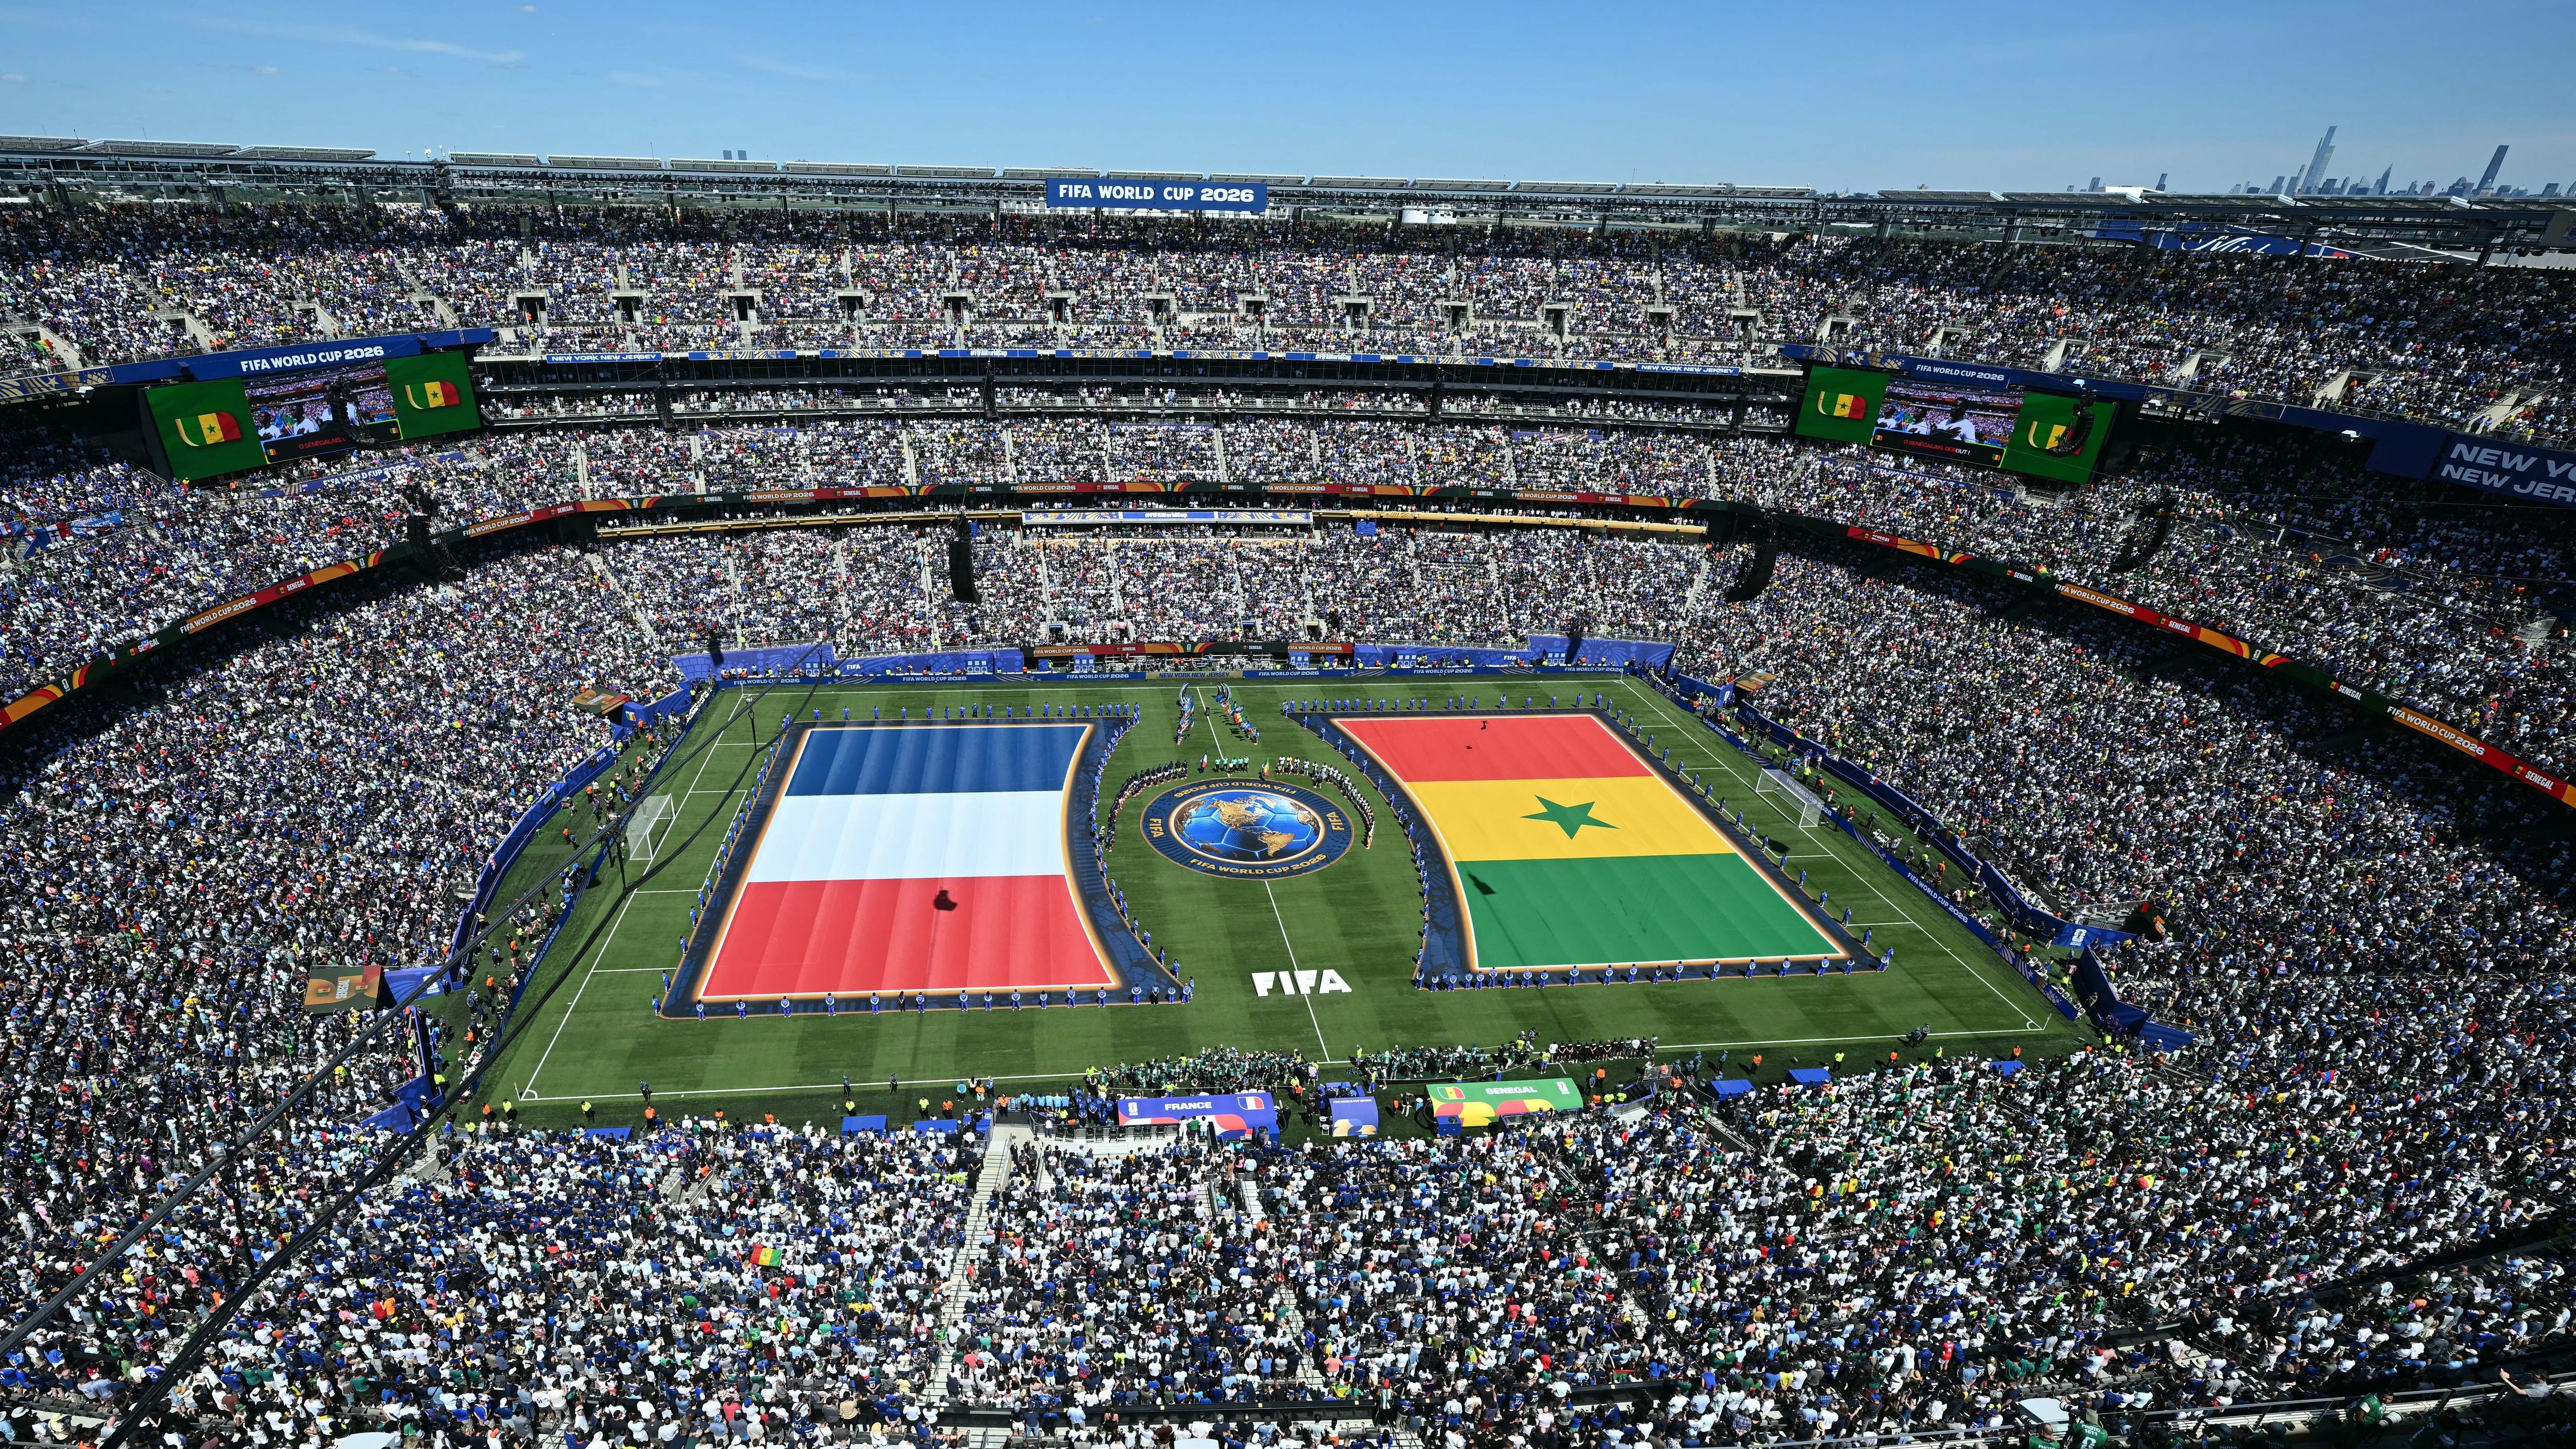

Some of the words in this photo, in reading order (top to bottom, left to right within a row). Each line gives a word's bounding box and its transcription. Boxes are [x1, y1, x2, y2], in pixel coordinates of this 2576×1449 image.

[1059, 185, 1092, 198] FIFA
[1098, 185, 1154, 200] WORLD
[1163, 187, 1194, 201] CUP
[1200, 188, 1254, 202] 2026
[241, 359, 271, 372] FIFA
[270, 354, 317, 368] WORLD
[319, 351, 342, 363] CUP
[343, 346, 384, 360] 2026
[1933, 366, 1960, 375] WORLD
[1976, 372, 2005, 381] 2026
[2450, 443, 2538, 472] NEW
[323, 478, 341, 486] FIFA
[2441, 464, 2510, 487] NEW
[2513, 481, 2576, 502] JER
[557, 505, 573, 514] SENEGAL
[475, 523, 496, 532] WORLD
[510, 515, 530, 524] 2026
[2014, 572, 2033, 582] SENEGAL
[287, 580, 306, 591] SENEGAL
[2055, 584, 2069, 592] FIFA
[2070, 588, 2096, 600] WORLD
[2096, 596, 2110, 605] CUP
[2110, 601, 2135, 614] 2026
[180, 623, 195, 634] FIFA
[194, 612, 218, 627] WORLD
[218, 607, 232, 617] CUP
[233, 598, 257, 611] 2026
[2168, 620, 2191, 633] SENEGAL
[137, 638, 160, 653] SEGAL
[2338, 685, 2362, 700] SENEGAL
[1746, 710, 1755, 720] FIFA
[1714, 726, 1727, 737] 2026
[2387, 706, 2406, 719] FIFA
[2407, 713, 2439, 732] WORLD
[2439, 728, 2456, 740] CUP
[2455, 736, 2485, 755] 2026
[596, 752, 606, 762] FIFA
[2525, 771, 2553, 790] SENEGAL
[1174, 785, 1208, 798] 2026
[1273, 785, 1297, 794] FIFA
[1786, 778, 1795, 788] FIFA
[1795, 784, 1809, 798] WORLD
[1808, 795, 1817, 805] CUP
[1817, 801, 1832, 816] 2026
[1150, 817, 1164, 838] FIFA
[1326, 811, 1345, 831] FIFA
[1190, 859, 1215, 870] FIFA
[1219, 866, 1264, 875] WORLD
[1291, 853, 1327, 870] 2026
[1907, 872, 1919, 884] FIFA
[1919, 881, 1938, 899] WORLD
[1937, 895, 1949, 907] CUP
[1948, 905, 1969, 923] 2026
[2005, 891, 2016, 905] FIFA
[524, 971, 532, 985] FIFA
[531, 951, 544, 973] WORLD
[549, 924, 560, 944] 2026
[1251, 969, 1352, 998] FIFA
[1485, 1086, 1538, 1095] SENEGAL
[1164, 1102, 1212, 1110] FRANCE
[2081, 1424, 2100, 1433] PHOTO
